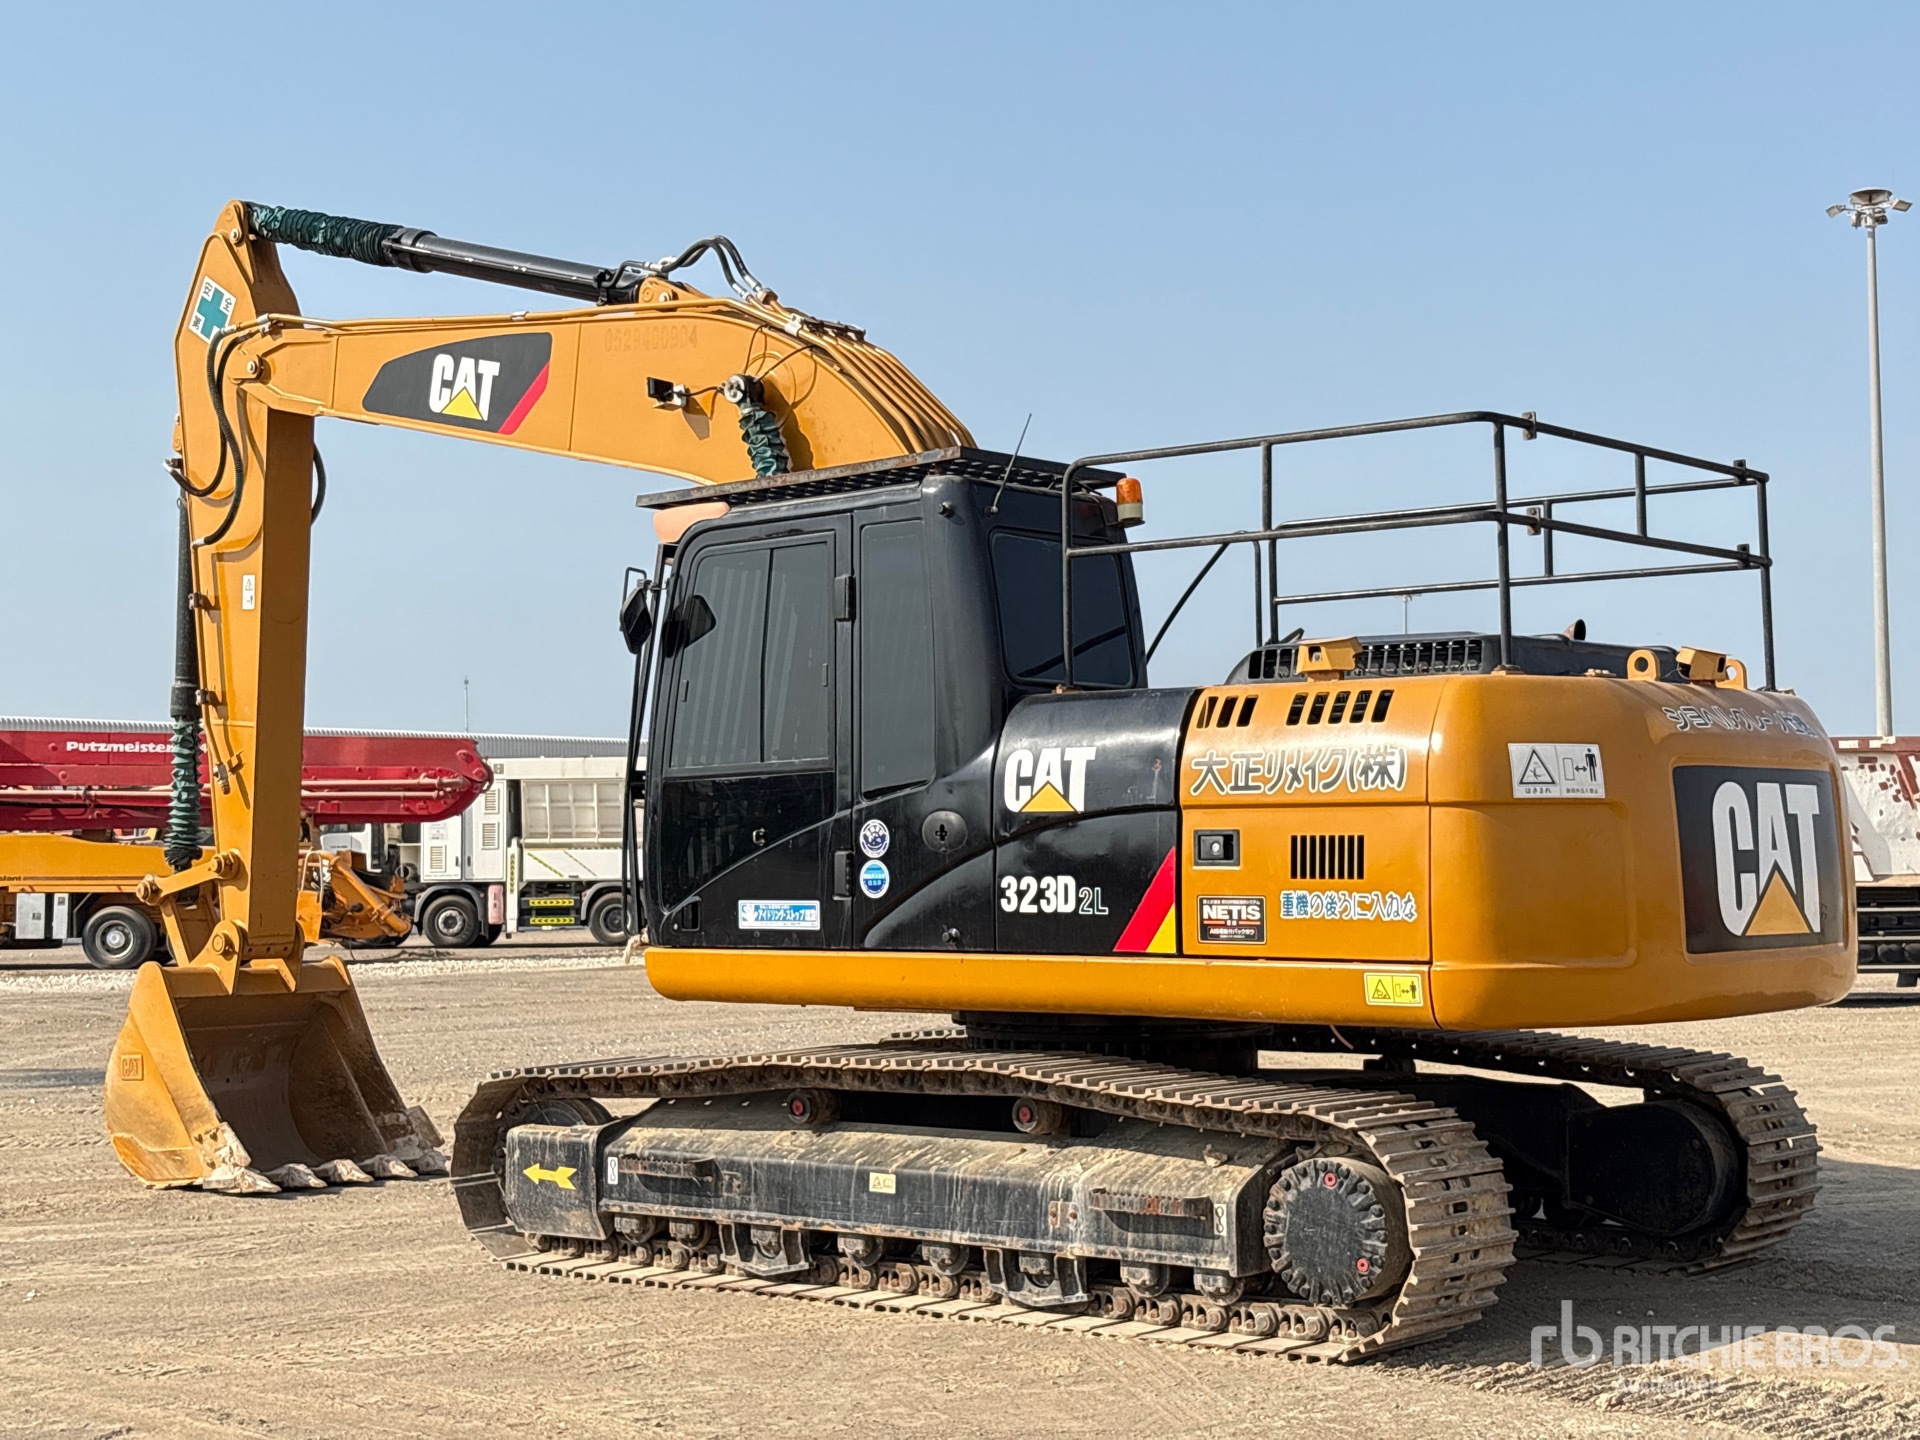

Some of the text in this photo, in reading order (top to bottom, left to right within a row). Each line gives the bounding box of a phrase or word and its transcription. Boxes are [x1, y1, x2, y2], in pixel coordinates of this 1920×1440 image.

[429, 353, 500, 421] CAT
[1004, 747, 1096, 814] CAT
[1712, 781, 1821, 937] CAT
[1203, 905, 1261, 920] NETIS
